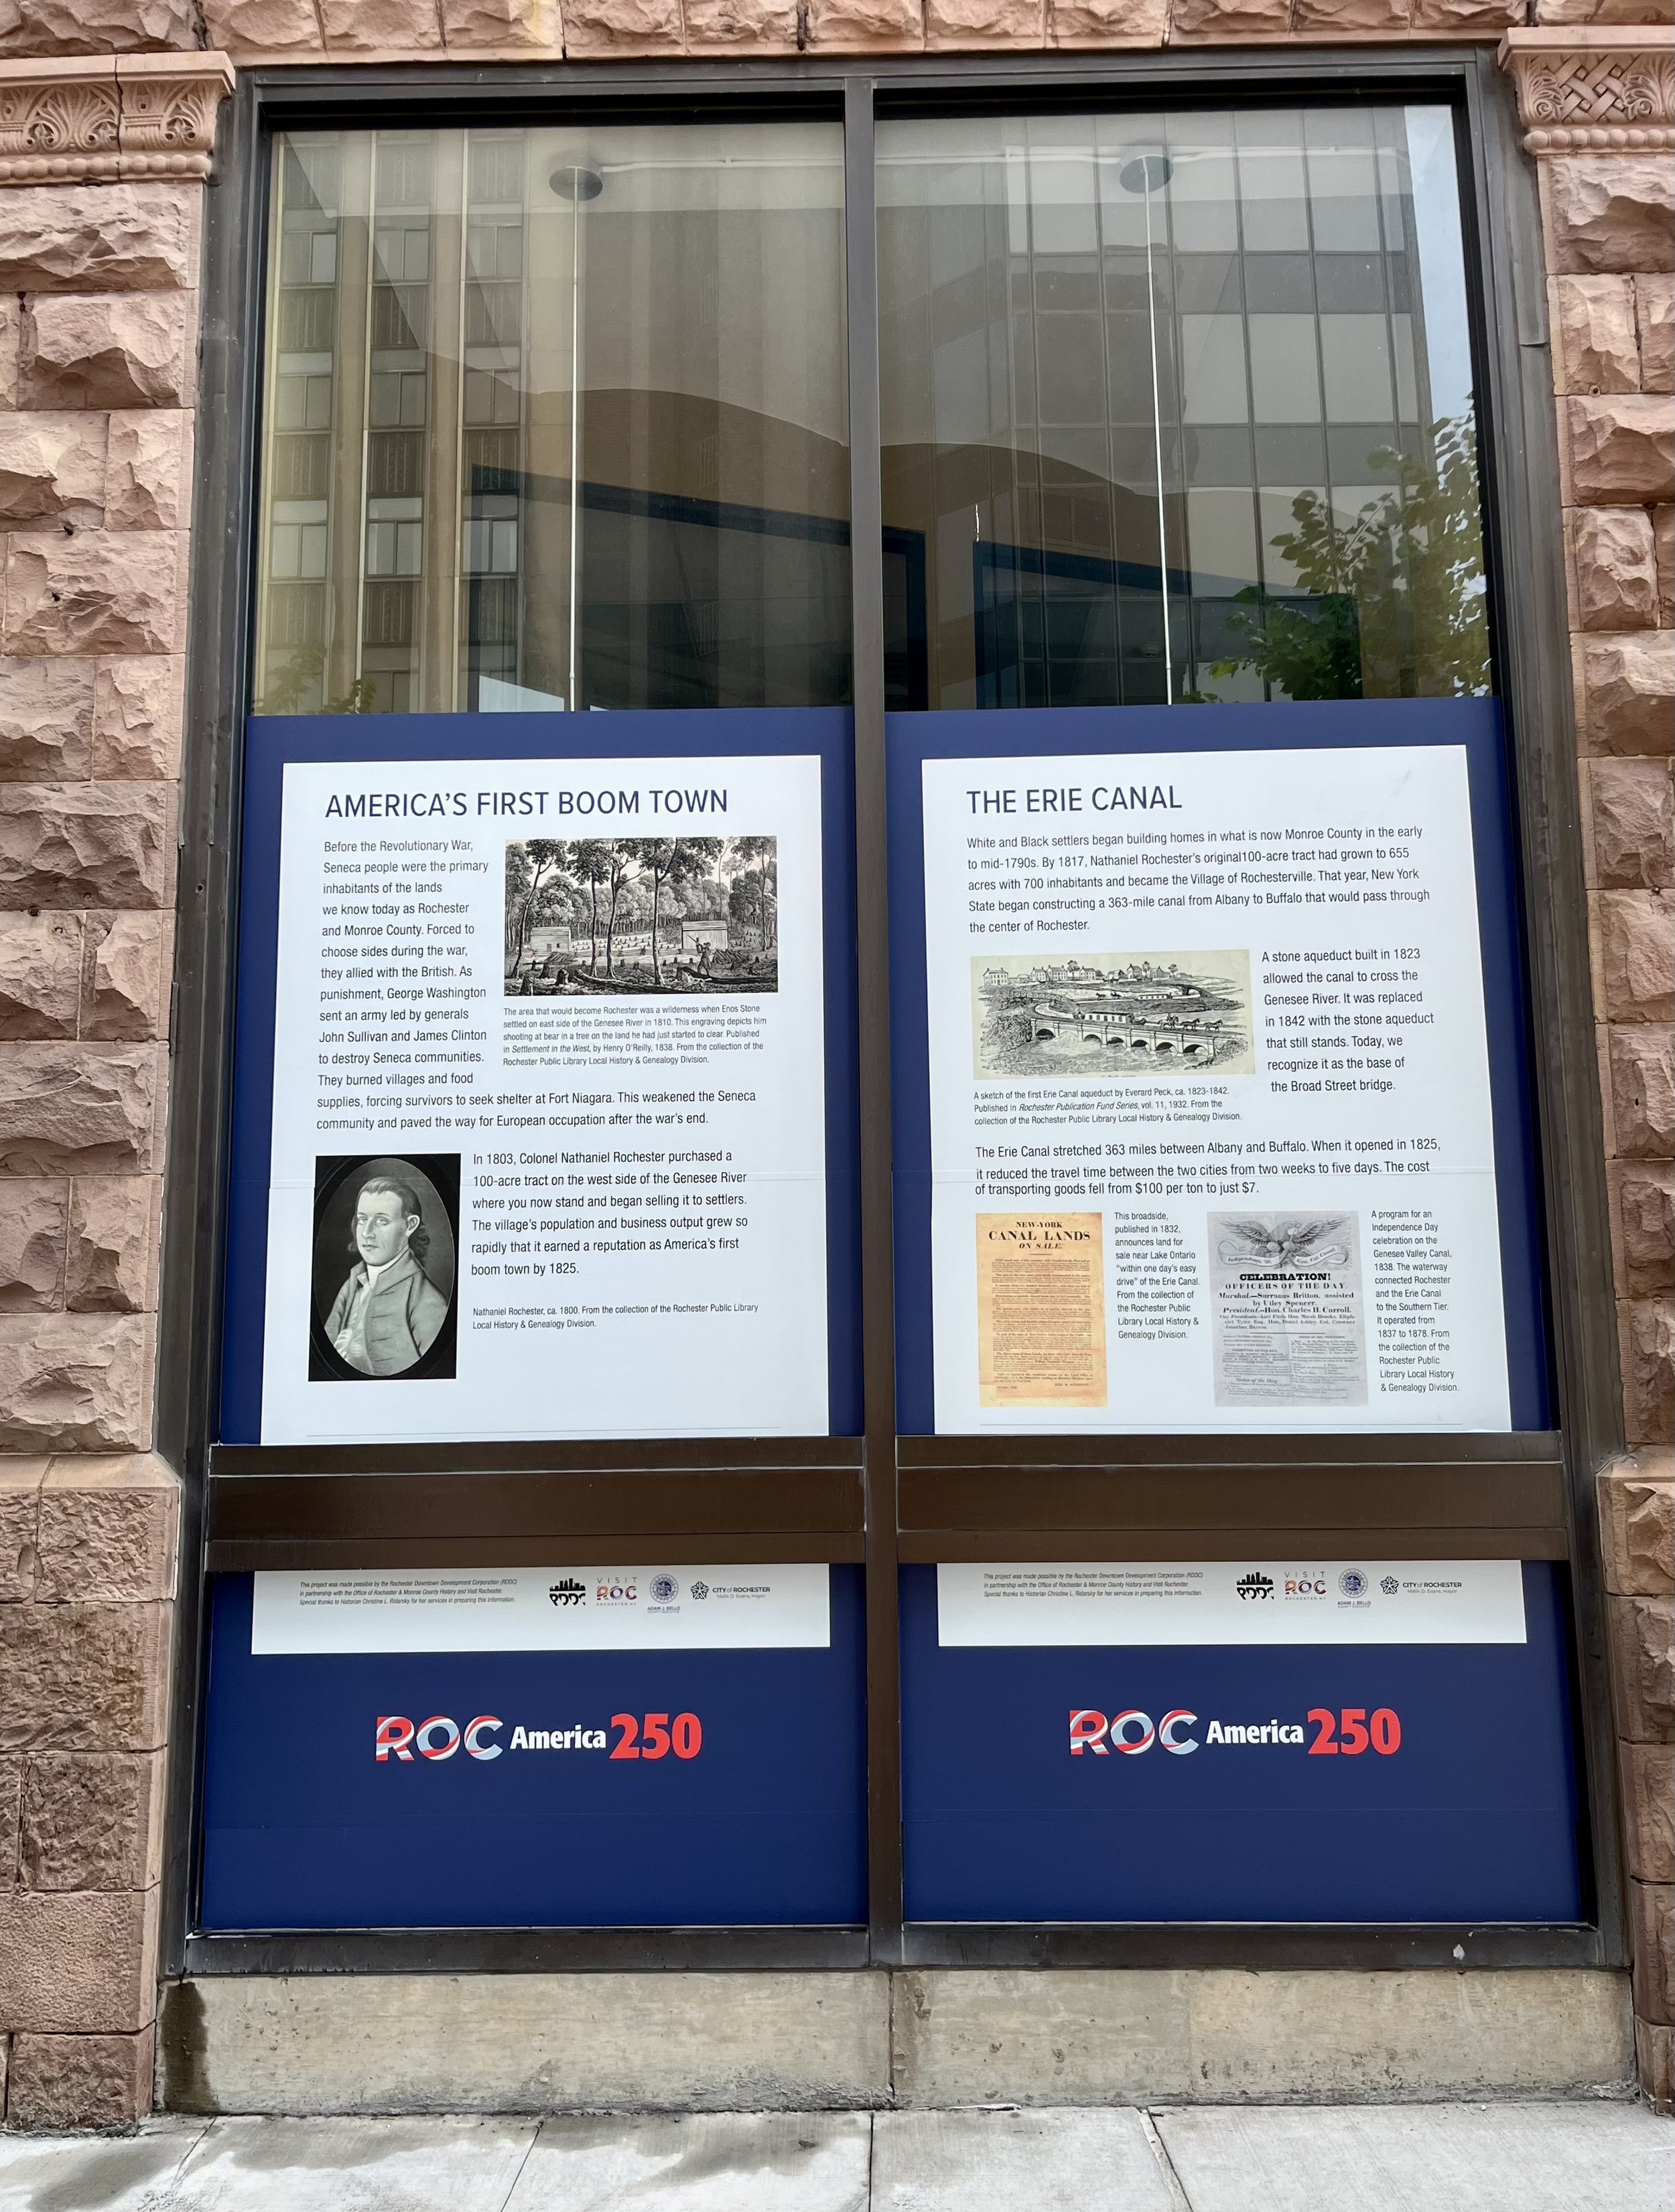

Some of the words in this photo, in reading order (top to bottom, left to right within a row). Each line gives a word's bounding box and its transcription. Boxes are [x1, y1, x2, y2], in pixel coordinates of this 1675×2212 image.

[477, 791, 549, 815] FIRST
[559, 790, 639, 814] BOOM
[649, 789, 726, 813] TOWN
[966, 789, 1016, 814] THE
[1026, 787, 1082, 812] ERIE
[1091, 785, 1182, 810] CANAL
[324, 841, 357, 852] Before
[360, 840, 377, 852] the
[379, 840, 448, 852] Revolutionary
[451, 839, 472, 852] War,
[323, 862, 361, 873] Seneca
[364, 861, 398, 874] people
[401, 862, 426, 872] were
[429, 860, 446, 871] the
[449, 860, 488, 873] primary
[969, 921, 985, 932] the
[988, 921, 1020, 932] center
[1024, 920, 1034, 931] of
[1036, 919, 1089, 931] Rochester.
[1262, 952, 1270, 962] A
[1272, 952, 1300, 962] stone
[1303, 950, 1352, 963] aqueduct
[1355, 949, 1378, 960] built
[1381, 949, 1390, 960] in
[1394, 948, 1420, 959] 1823
[320, 988, 383, 1002] punishment,
[387, 988, 423, 1000] George
[426, 986, 486, 1000] Washington
[1264, 994, 1309, 1005] Genesee
[1312, 993, 1340, 1004] River.
[1343, 992, 1351, 1003] It
[1353, 994, 1375, 1003] was
[1378, 991, 1422, 1004] replaced
[503, 1007, 517, 1015] The
[535, 1007, 549, 1015] that
[551, 1006, 572, 1015] would
[574, 1006, 602, 1015] become
[603, 1006, 638, 1014] Rochester
[661, 1005, 699, 1013] wilderness
[722, 1004, 738, 1013] Enos
[740, 1004, 760, 1012] Stone
[318, 1053, 328, 1064] to
[331, 1053, 370, 1065] destroy
[373, 1051, 411, 1063] Seneca
[414, 1051, 484, 1063] communities.
[318, 1074, 343, 1088] They
[346, 1074, 382, 1085] burned
[385, 1073, 425, 1086] villages
[428, 1072, 447, 1084] and
[450, 1072, 473, 1084] food
[1270, 1081, 1288, 1092] the
[1290, 1080, 1321, 1092] Broad
[1325, 1080, 1356, 1091] Street
[1359, 1078, 1395, 1092] bridge.
[974, 1116, 1008, 1125] collection
[1009, 1116, 1016, 1124] of
[1031, 1116, 1067, 1124] Rochester
[1068, 1115, 1089, 1123] Public
[1091, 1114, 1116, 1124] Library
[1118, 1114, 1137, 1122] Local
[1139, 1114, 1164, 1122] History
[1165, 1113, 1171, 1121] &
[1173, 1112, 1210, 1122] Genealogy
[1212, 1112, 1242, 1120] Division.
[474, 1153, 482, 1164] In
[486, 1153, 516, 1165] 1803,
[519, 1152, 557, 1164] Colonel
[561, 1151, 610, 1163] Nathaniel
[614, 1151, 665, 1163] Rochester
[669, 1150, 722, 1164] purchased
[726, 1152, 732, 1161] a
[1114, 1212, 1130, 1220] This
[1131, 1212, 1168, 1221] broadside,
[1115, 1225, 1149, 1234] published
[1160, 1224, 1181, 1234] 1832,
[1371, 1223, 1422, 1232] Independence
[1424, 1222, 1438, 1232] Day
[988, 1230, 1036, 1240] CANAL
[1045, 1231, 1090, 1240] LANDS
[1115, 1251, 1130, 1259] sale
[1150, 1250, 1167, 1259] Lake
[1169, 1250, 1195, 1259] Ontario
[1373, 1249, 1404, 1258] Genesee
[1406, 1249, 1427, 1259] Valley
[1429, 1248, 1451, 1258] Canal,
[471, 1264, 500, 1275] boom
[504, 1263, 529, 1275] town
[533, 1262, 545, 1277] by
[549, 1262, 579, 1274] 1825.
[1374, 1276, 1412, 1284] connected
[1414, 1275, 1451, 1284] Rochester
[1376, 1303, 1384, 1311] to
[1385, 1303, 1397, 1311] the
[1399, 1302, 1432, 1311] Southern
[1433, 1302, 1447, 1310] Tier.
[472, 1321, 491, 1329] Local
[493, 1321, 519, 1329] History
[520, 1319, 525, 1328] &
[528, 1319, 565, 1329] Genealogy
[567, 1319, 596, 1327] Division.
[596, 1585, 637, 1600] ROC
[1284, 1580, 1327, 1594] ROC
[376, 1715, 503, 1761] ROC
[510, 1724, 606, 1750] America
[608, 1713, 702, 1759] 250
[1069, 1709, 1199, 1755] ROC
[1205, 1719, 1304, 1744] America
[1307, 1708, 1401, 1755] 250
